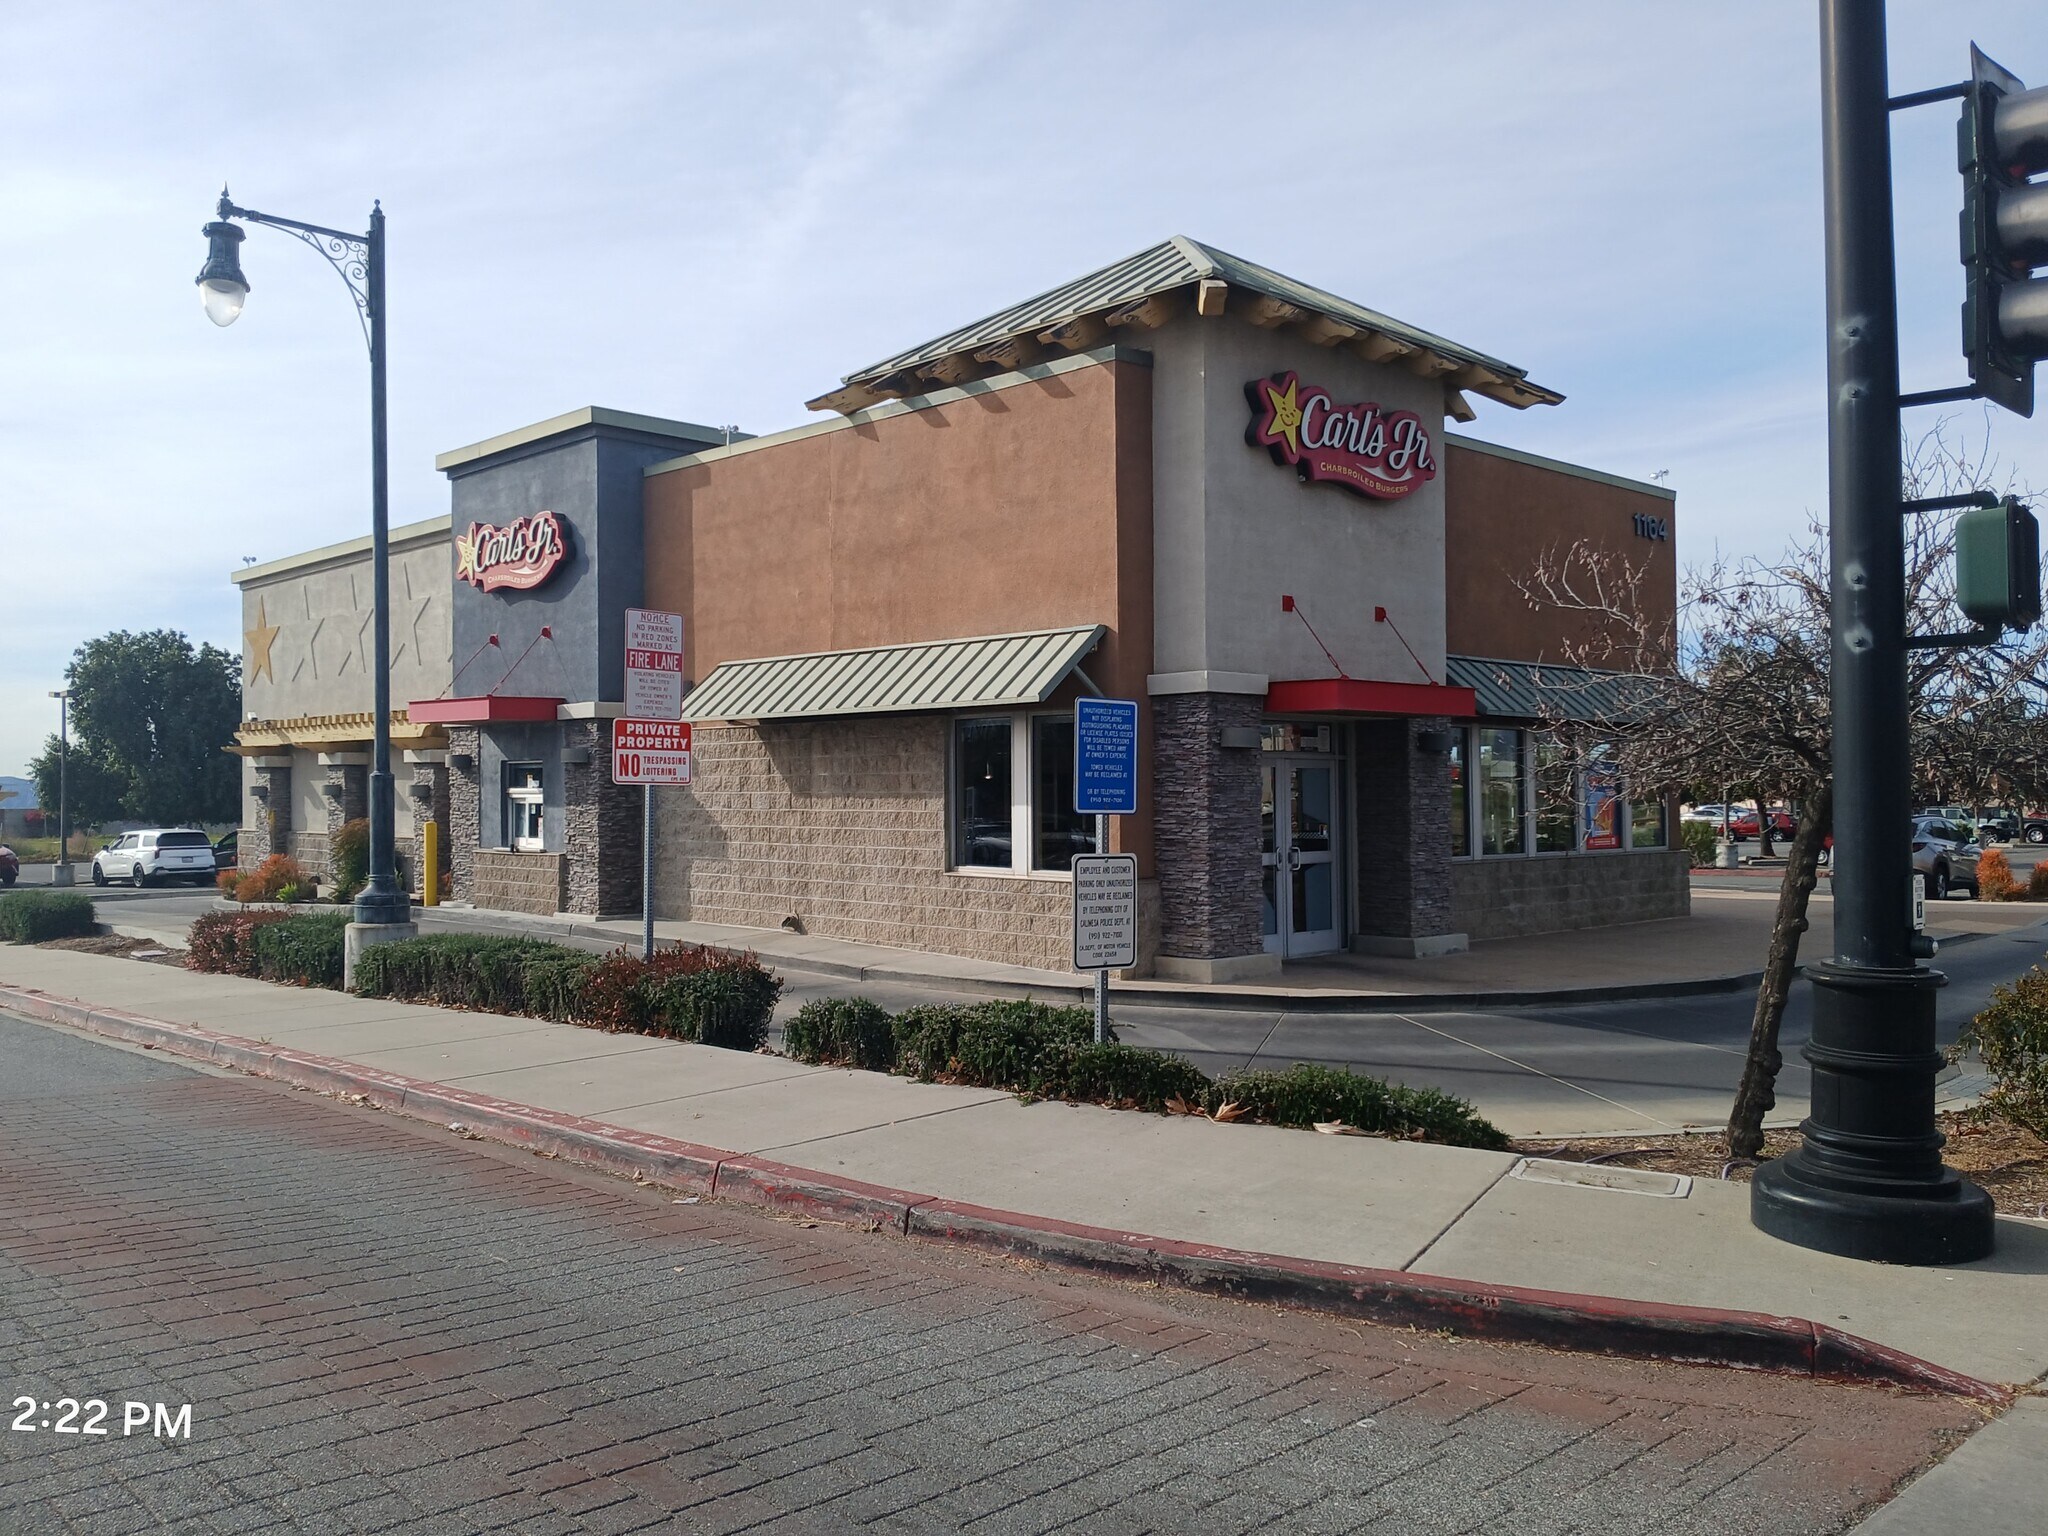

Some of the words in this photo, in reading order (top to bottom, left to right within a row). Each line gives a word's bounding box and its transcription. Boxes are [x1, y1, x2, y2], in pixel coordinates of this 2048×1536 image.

[1300, 394, 1388, 458] Carl's
[1388, 418, 1435, 470] Jr.
[1320, 461, 1375, 488] CHARBROILED
[1376, 482, 1408, 494] BURGERS
[474, 522, 526, 572] Carl's
[526, 518, 558, 564] Jr.
[640, 612, 670, 624] NOTICE
[648, 625, 674, 634] PARKING
[642, 633, 654, 641] RED
[657, 634, 678, 643] ZONES
[637, 642, 662, 650] MARKED
[629, 651, 651, 668] FIRE
[655, 653, 680, 671] LANE
[626, 723, 680, 736] PRIVATE
[618, 736, 688, 749] PROPERTY
[619, 754, 640, 777] NO
[643, 756, 687, 765] TRESPASSING
[643, 768, 677, 776] LOITERING
[1111, 866, 1131, 874] CUSTOMER
[1078, 892, 1097, 901] VEHICLES
[1106, 892, 1111, 900] BE
[1113, 892, 1132, 900] RECLAIMED
